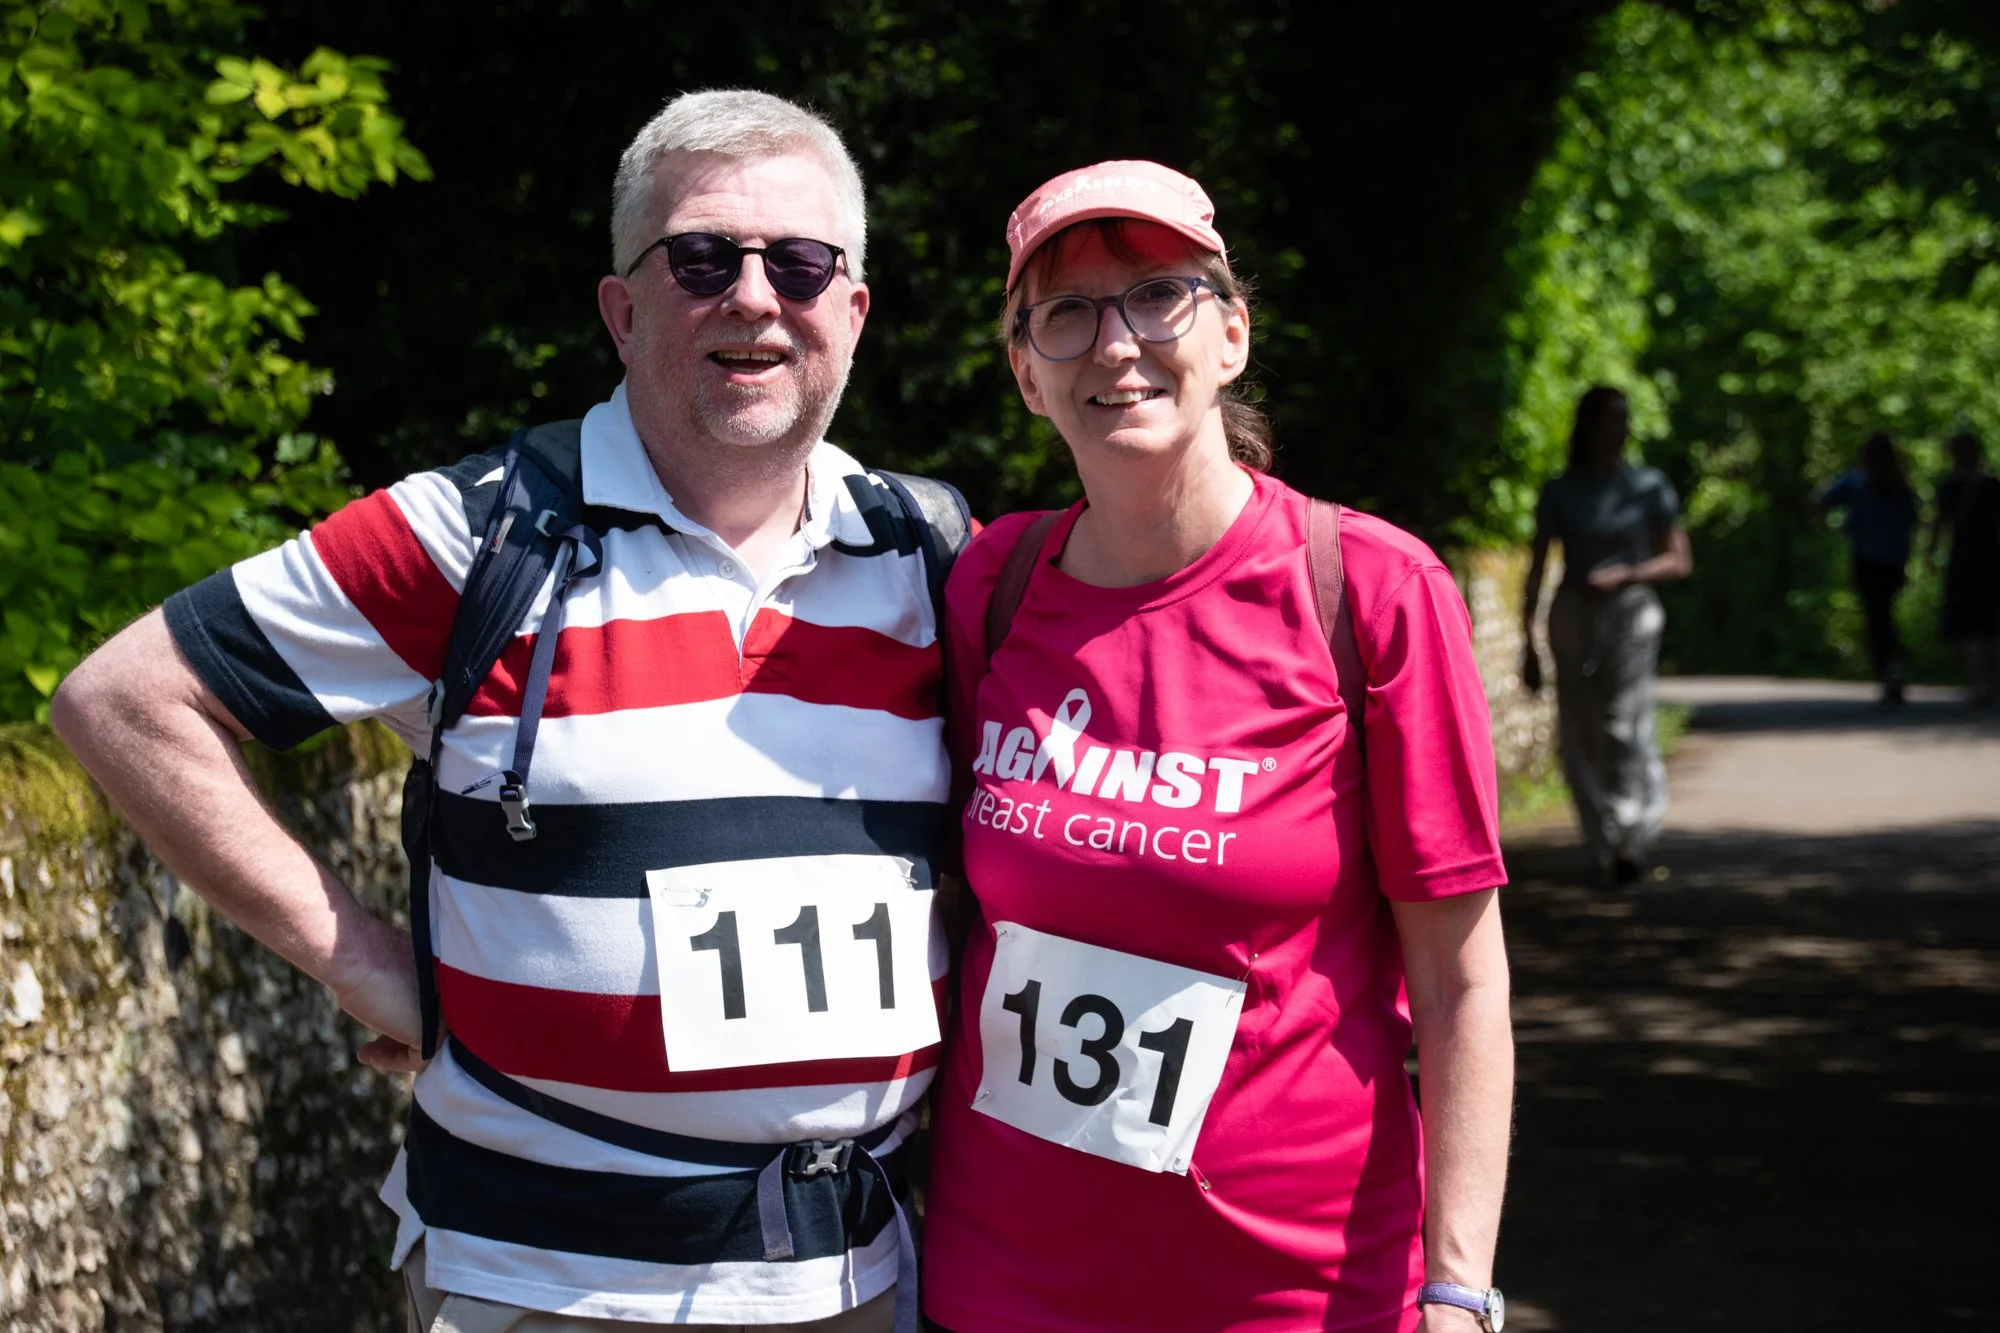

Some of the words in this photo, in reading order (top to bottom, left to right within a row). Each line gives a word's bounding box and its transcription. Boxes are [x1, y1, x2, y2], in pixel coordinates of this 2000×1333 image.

[1063, 813, 1237, 866] cancer
[690, 902, 896, 1020] 111
[1002, 979, 1194, 1128] 131
